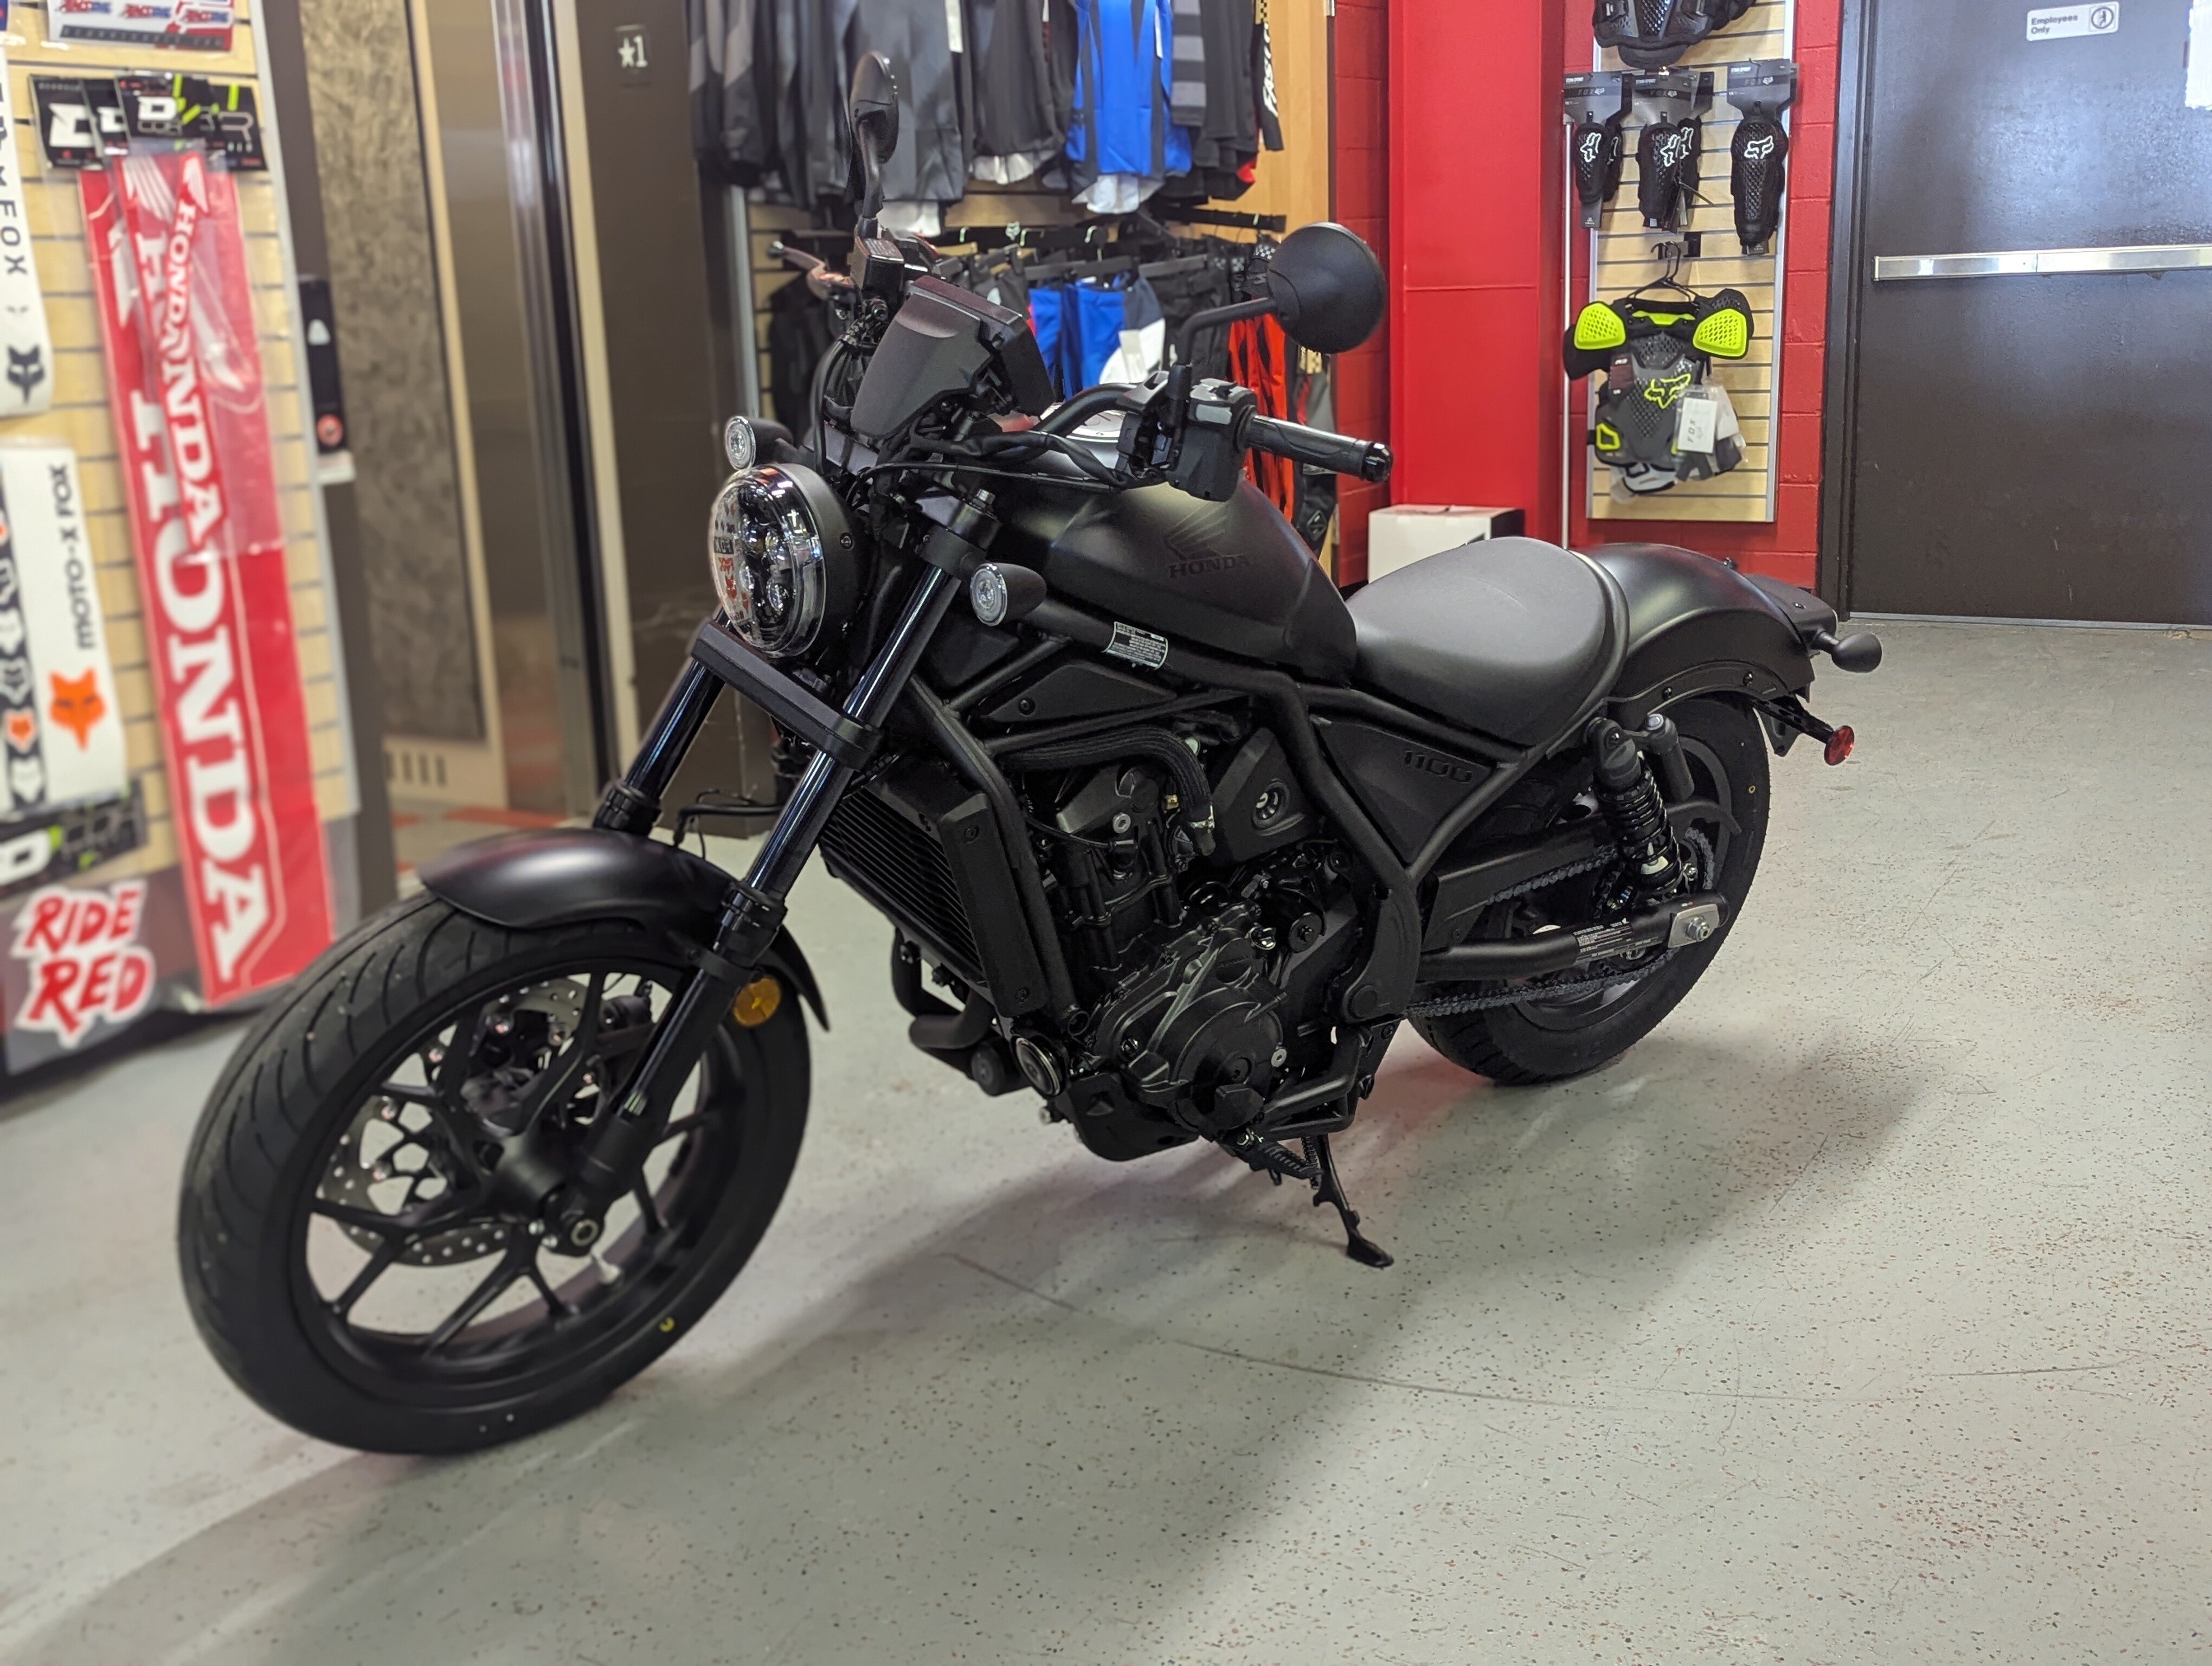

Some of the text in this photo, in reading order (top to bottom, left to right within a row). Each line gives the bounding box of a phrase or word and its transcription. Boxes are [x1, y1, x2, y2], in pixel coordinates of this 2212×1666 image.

[2031, 15, 2078, 25] Employees
[0, 200, 28, 274] FOX
[160, 200, 196, 353] HONDA
[48, 464, 97, 650] MOTO-X FOX
[1404, 750, 1473, 783] 1100
[23, 888, 142, 953] RIDE
[27, 953, 150, 1035] RED
